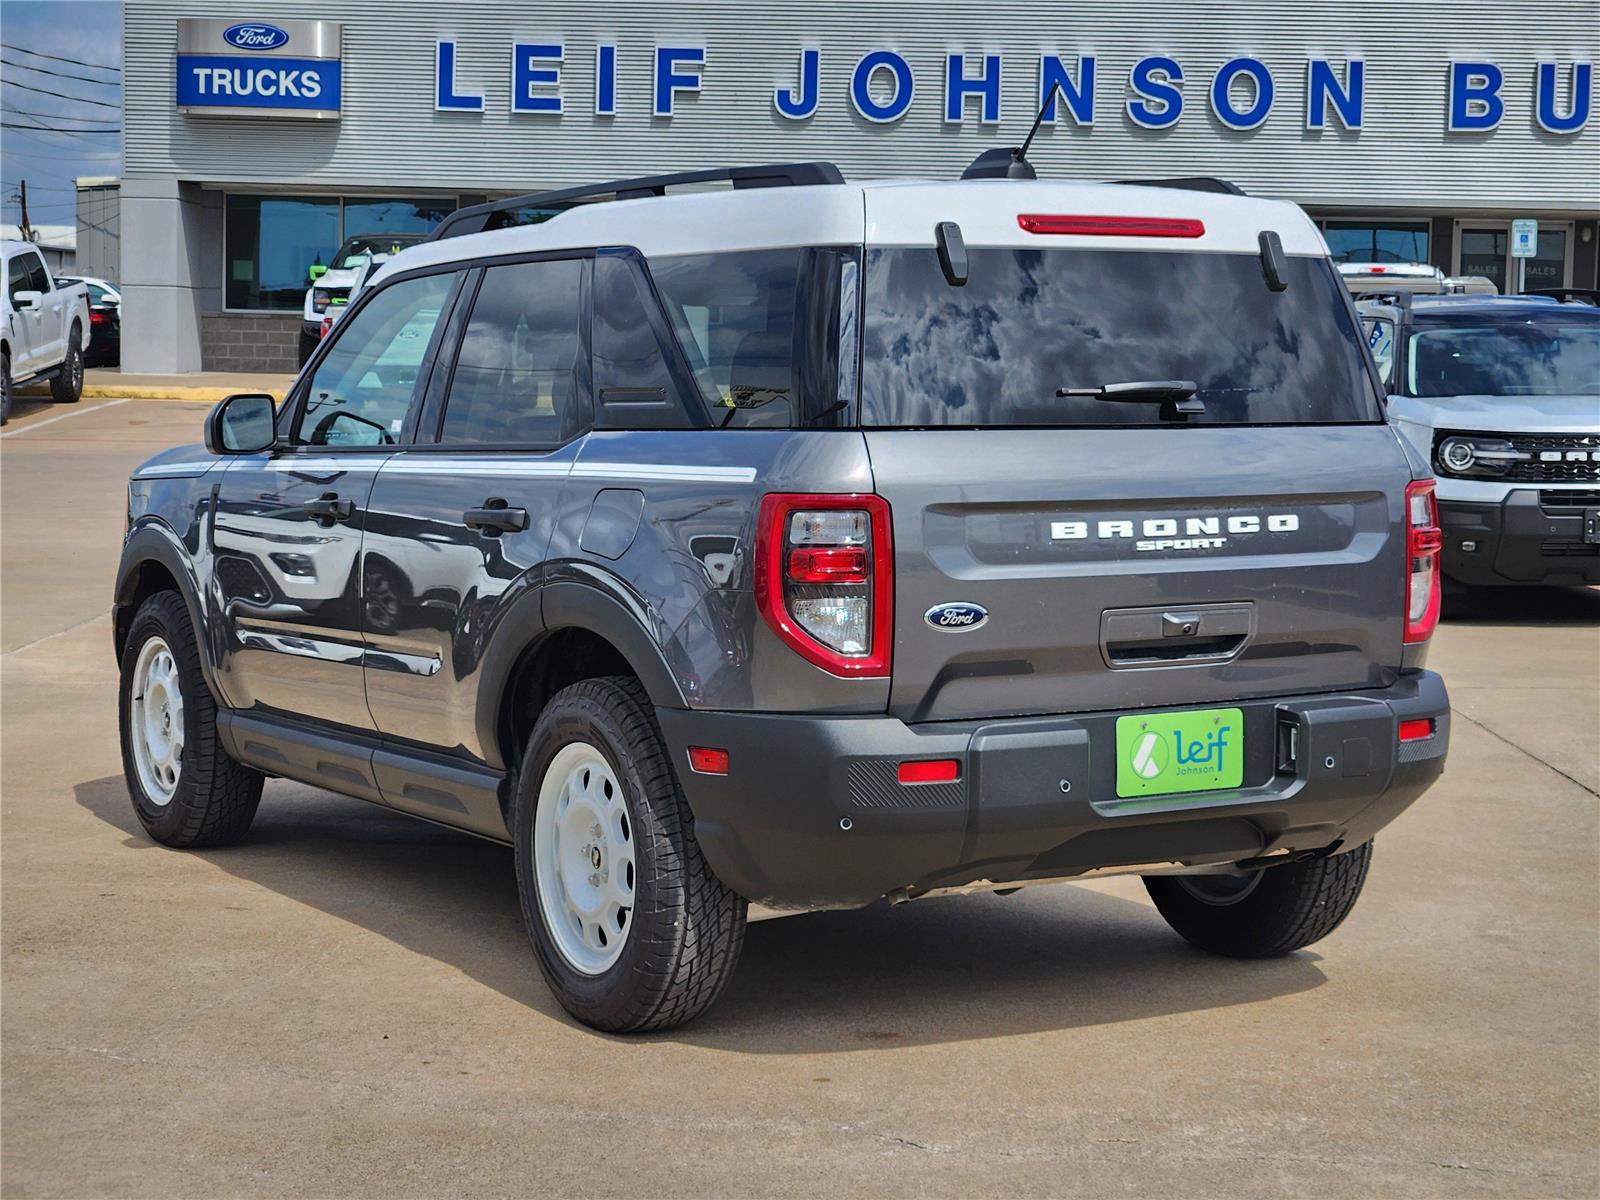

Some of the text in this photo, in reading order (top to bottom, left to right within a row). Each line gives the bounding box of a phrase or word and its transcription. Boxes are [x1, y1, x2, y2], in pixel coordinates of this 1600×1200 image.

[236, 27, 275, 45] Ford
[192, 67, 322, 98] TRUCKS
[434, 40, 706, 117] LEIF
[773, 48, 1367, 132] JOHNSON
[1467, 264, 1498, 274] SALES
[1526, 266, 1557, 276] SALES
[1050, 514, 1299, 539] BRONCO
[1136, 537, 1228, 551] SPORT
[940, 608, 975, 625] Ford
[1173, 726, 1231, 772] leif
[1176, 766, 1215, 776] Johnson
